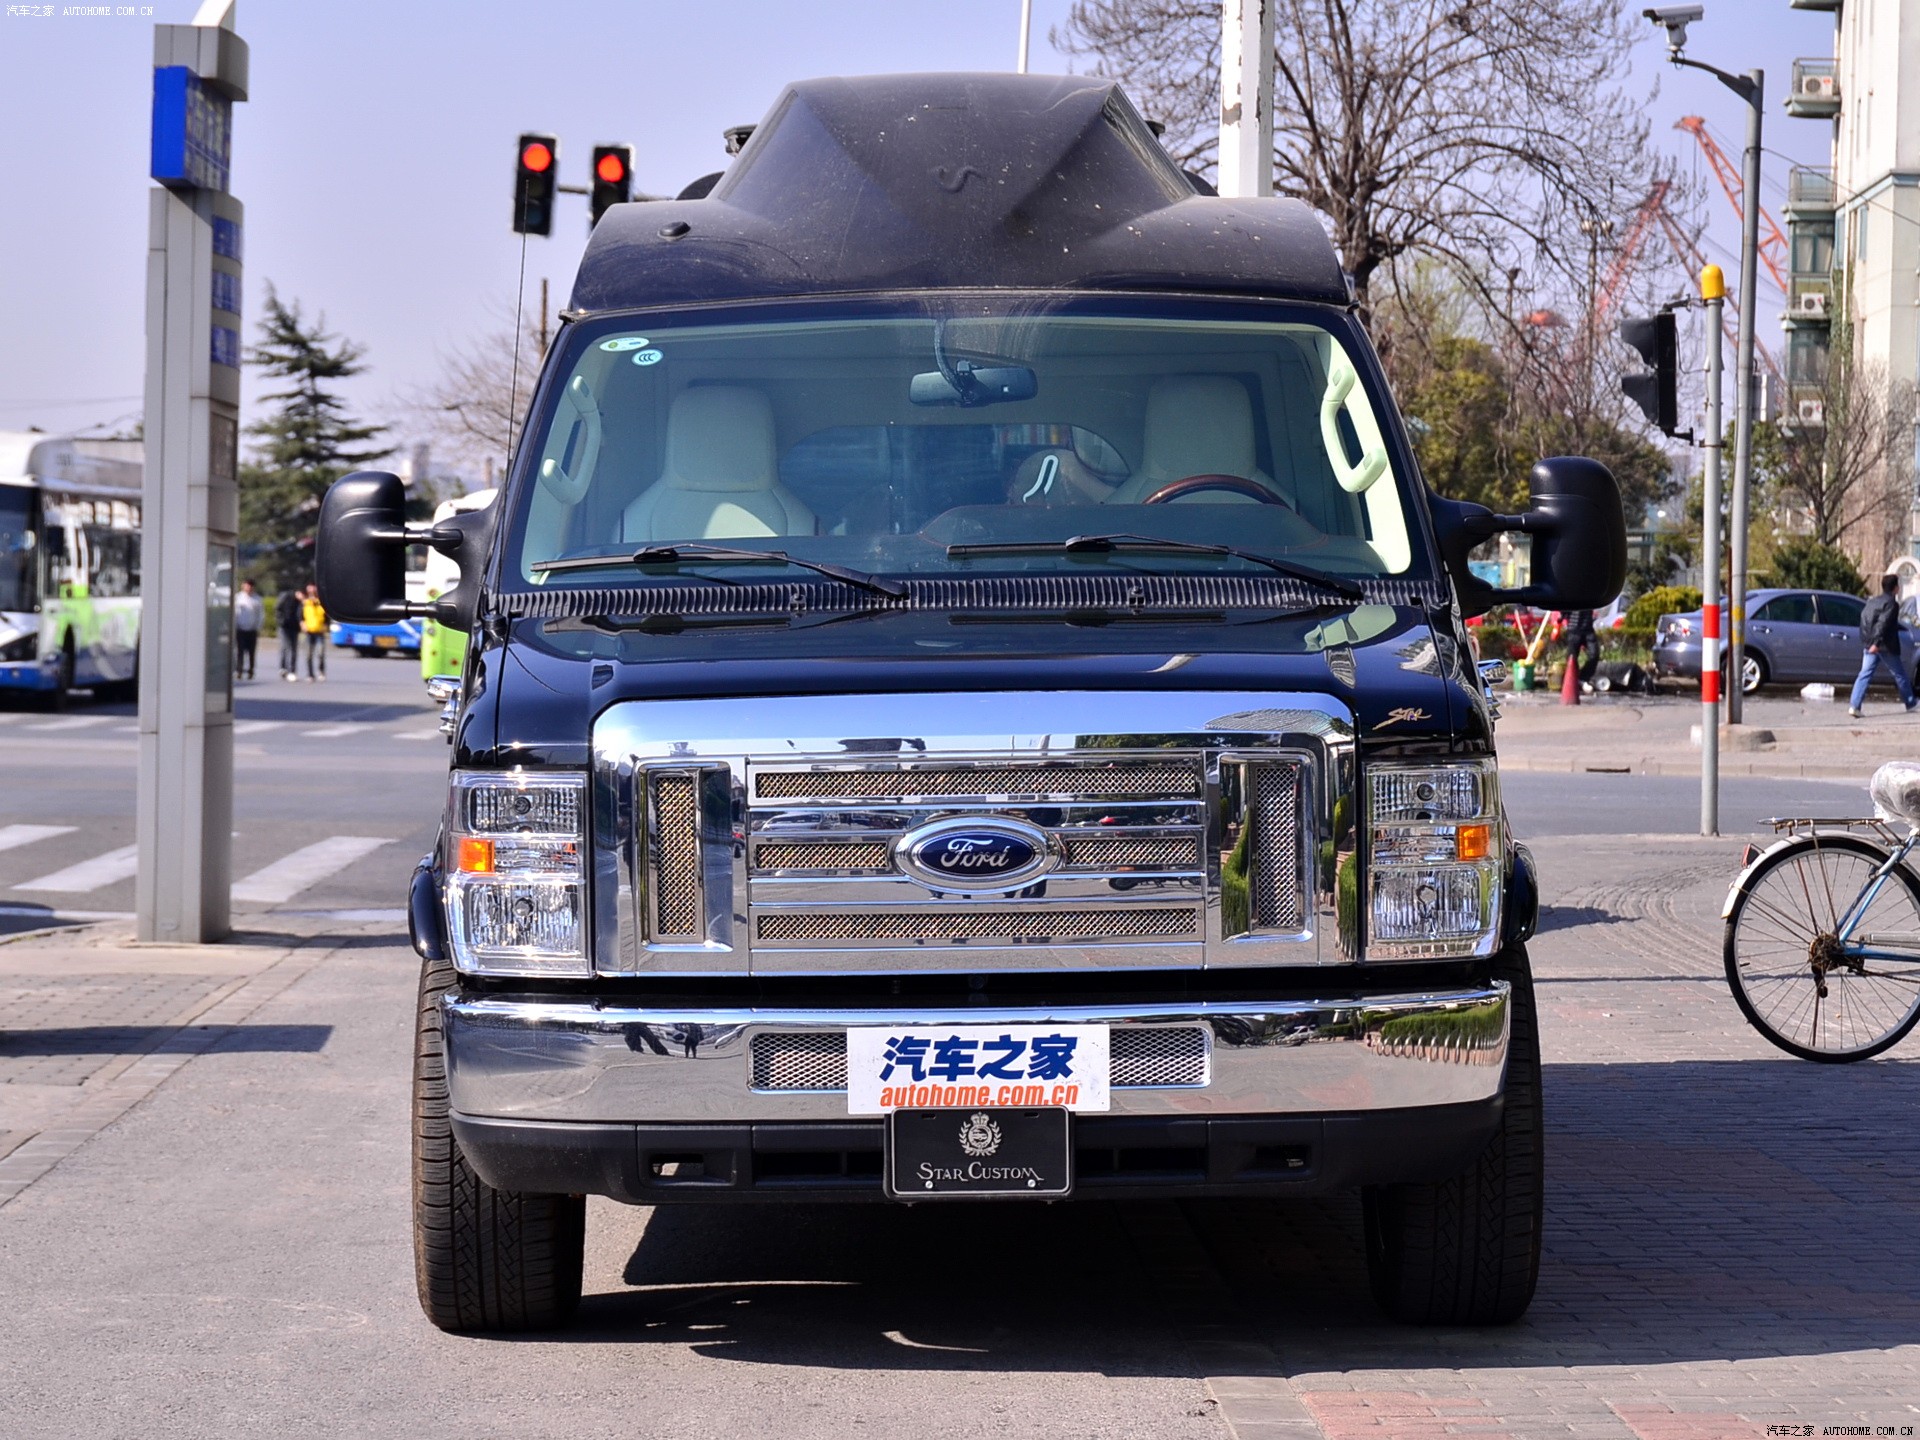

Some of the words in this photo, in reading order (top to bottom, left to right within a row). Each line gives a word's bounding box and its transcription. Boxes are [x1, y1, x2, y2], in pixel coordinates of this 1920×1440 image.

[940, 838, 1010, 868] Ford
[879, 1033, 1078, 1082] 汽车之家
[880, 1083, 1078, 1106] autohome.com.cn
